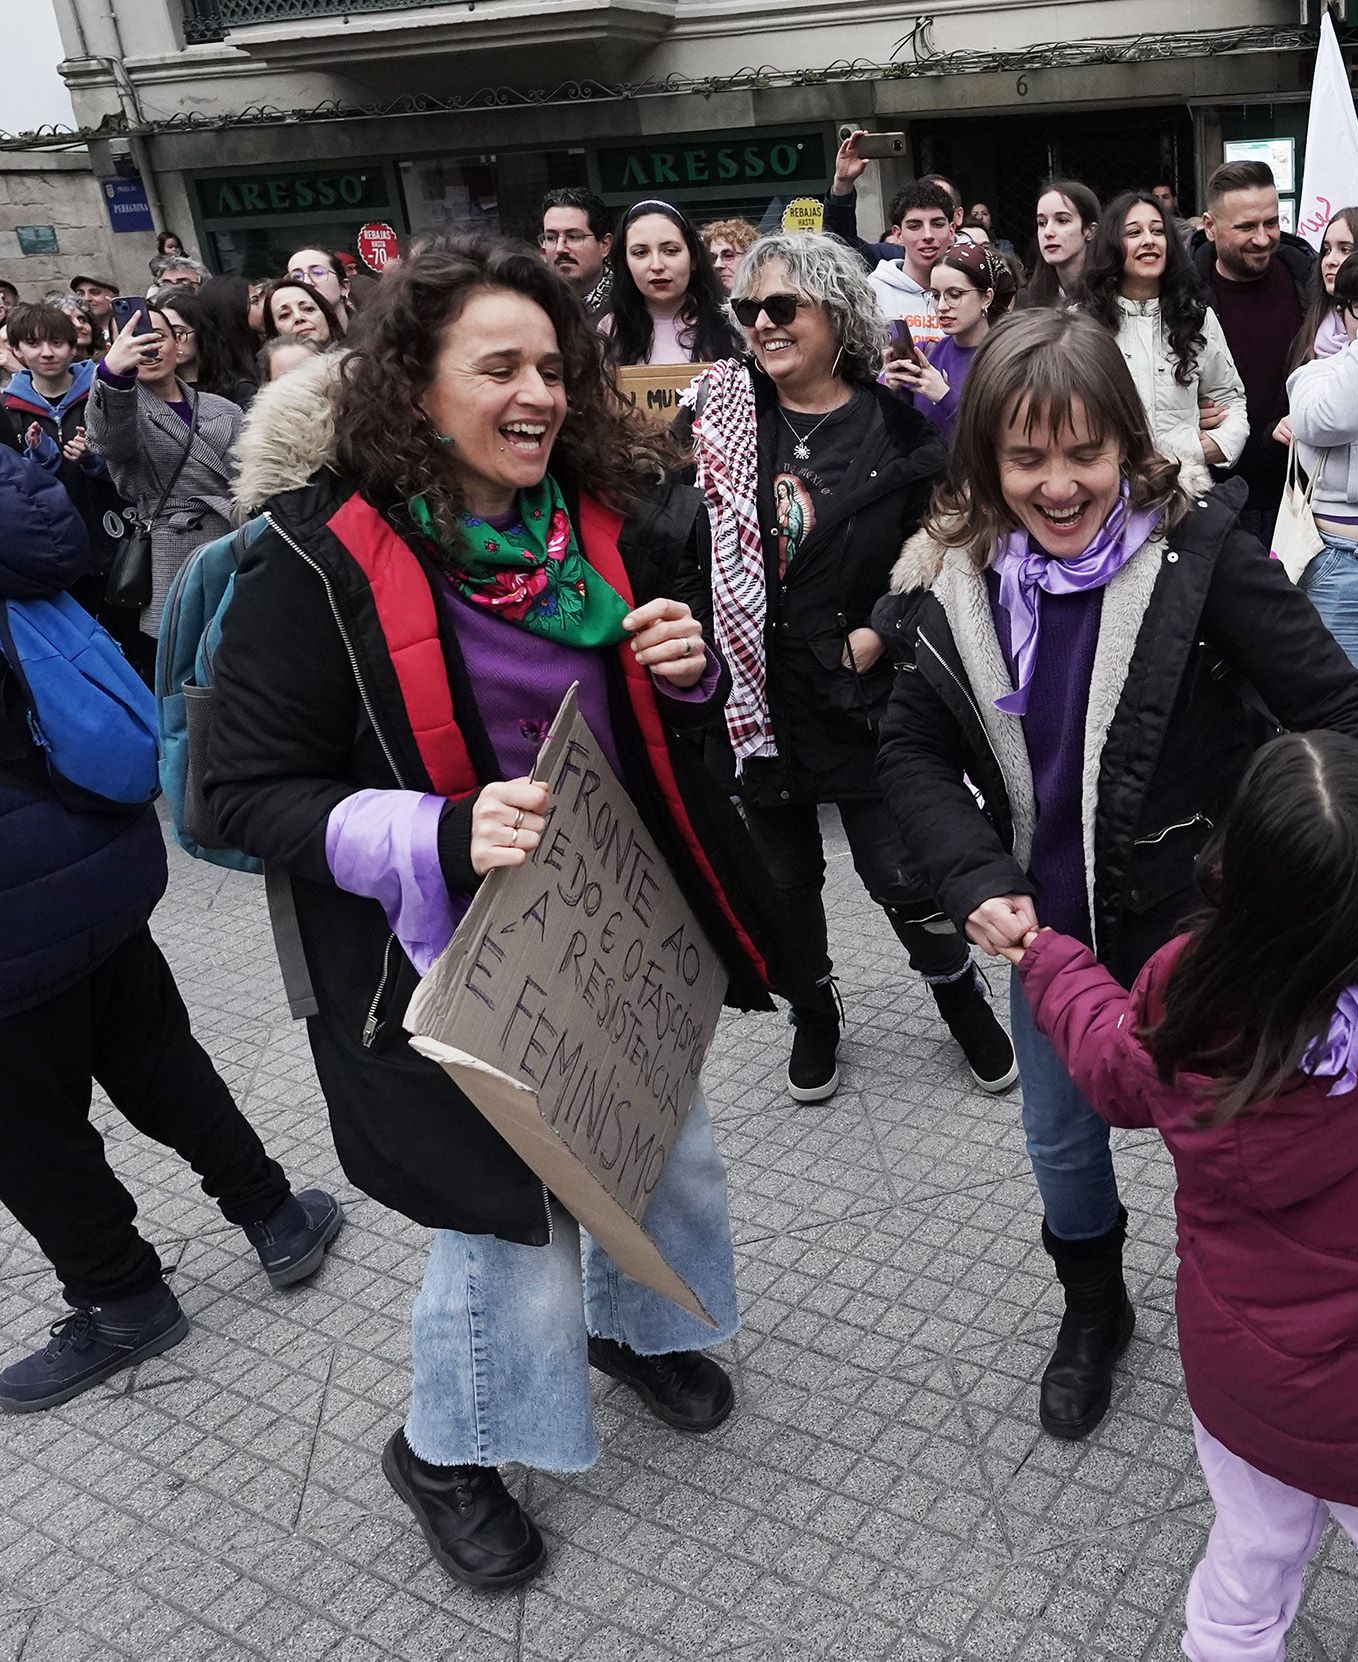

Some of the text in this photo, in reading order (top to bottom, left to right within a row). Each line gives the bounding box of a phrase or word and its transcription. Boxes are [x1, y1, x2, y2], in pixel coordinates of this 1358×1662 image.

[1016, 74, 1028, 97] 6
[622, 144, 798, 186] ARESSO
[219, 175, 363, 213] ARESSO
[790, 207, 822, 217] REBAJAS
[798, 218, 815, 226] HASTA
[363, 229, 392, 240] REBAJAS
[553, 738, 700, 986] FRONTE AO
[623, 938, 644, 983] O
